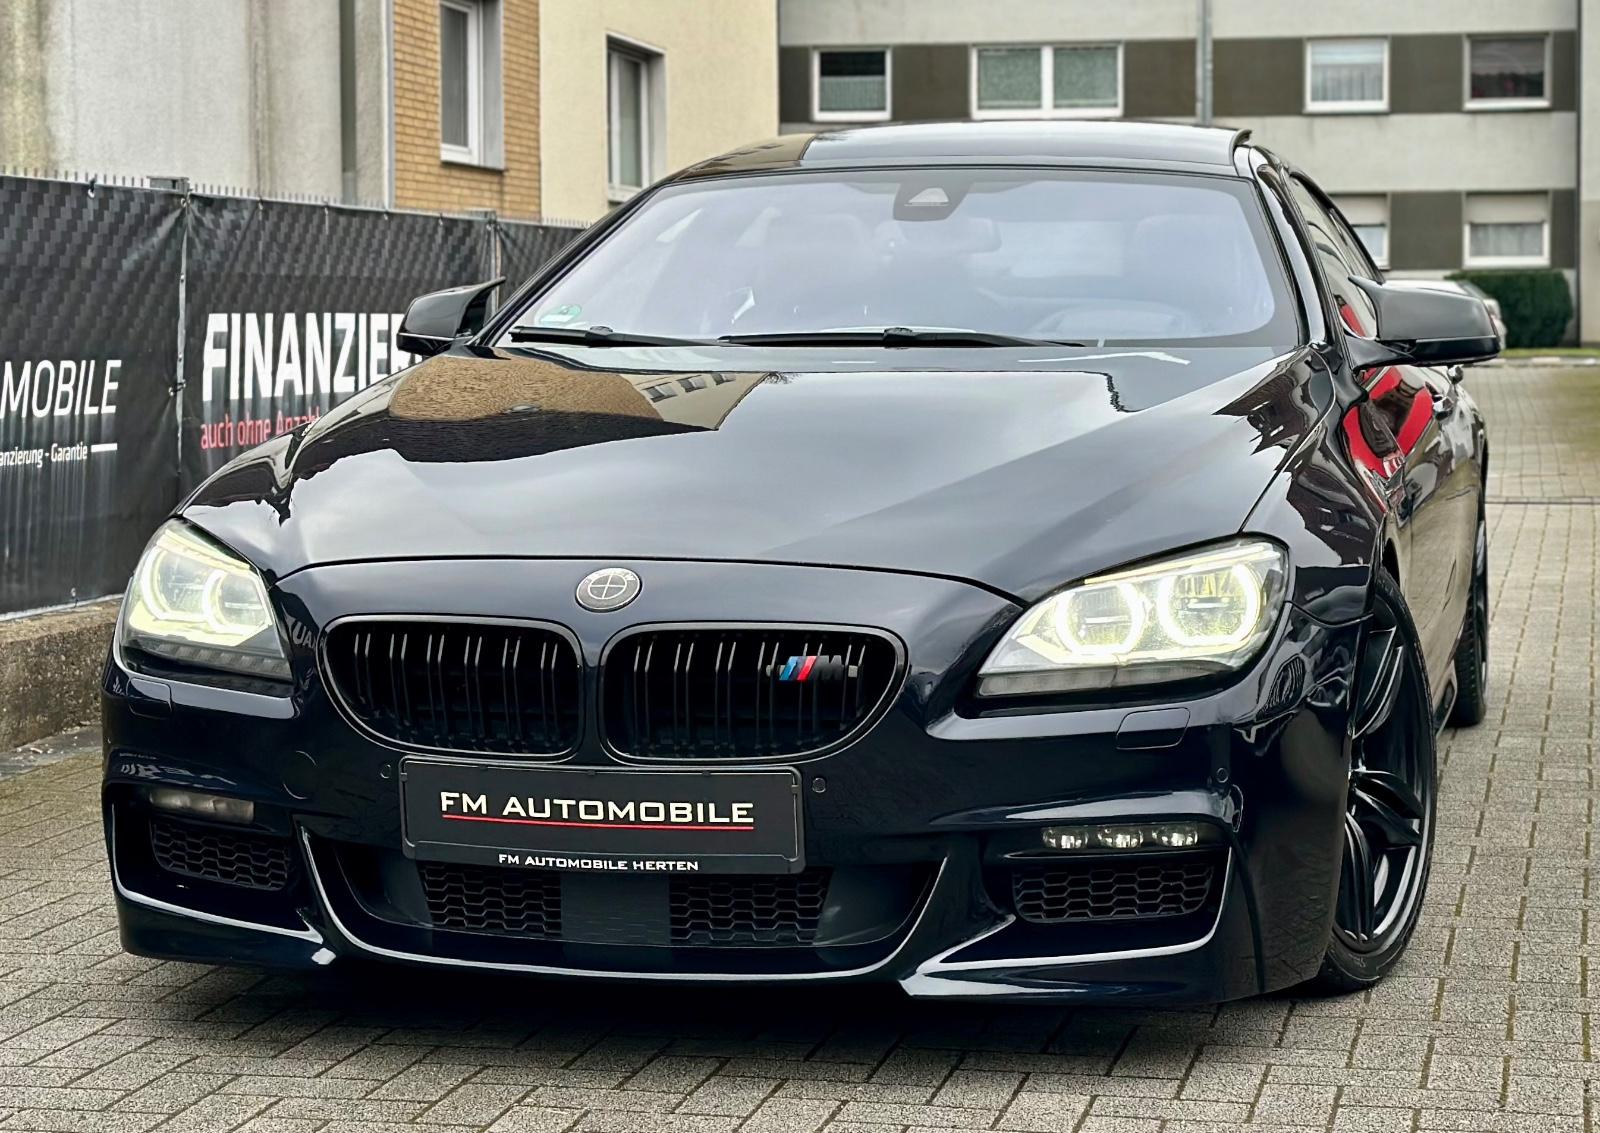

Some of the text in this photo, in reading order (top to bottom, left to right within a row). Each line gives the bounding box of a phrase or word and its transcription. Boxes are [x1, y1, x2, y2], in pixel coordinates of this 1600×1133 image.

[203, 313, 422, 401] FINANZIER
[0, 360, 122, 419] MOBILE
[201, 413, 234, 449] auch
[237, 411, 271, 446] ohne
[51, 441, 88, 462] Garantie
[440, 791, 755, 823] FM AUTOMOBILE
[498, 853, 699, 872] FM AUTOMOBILE HERTEN
